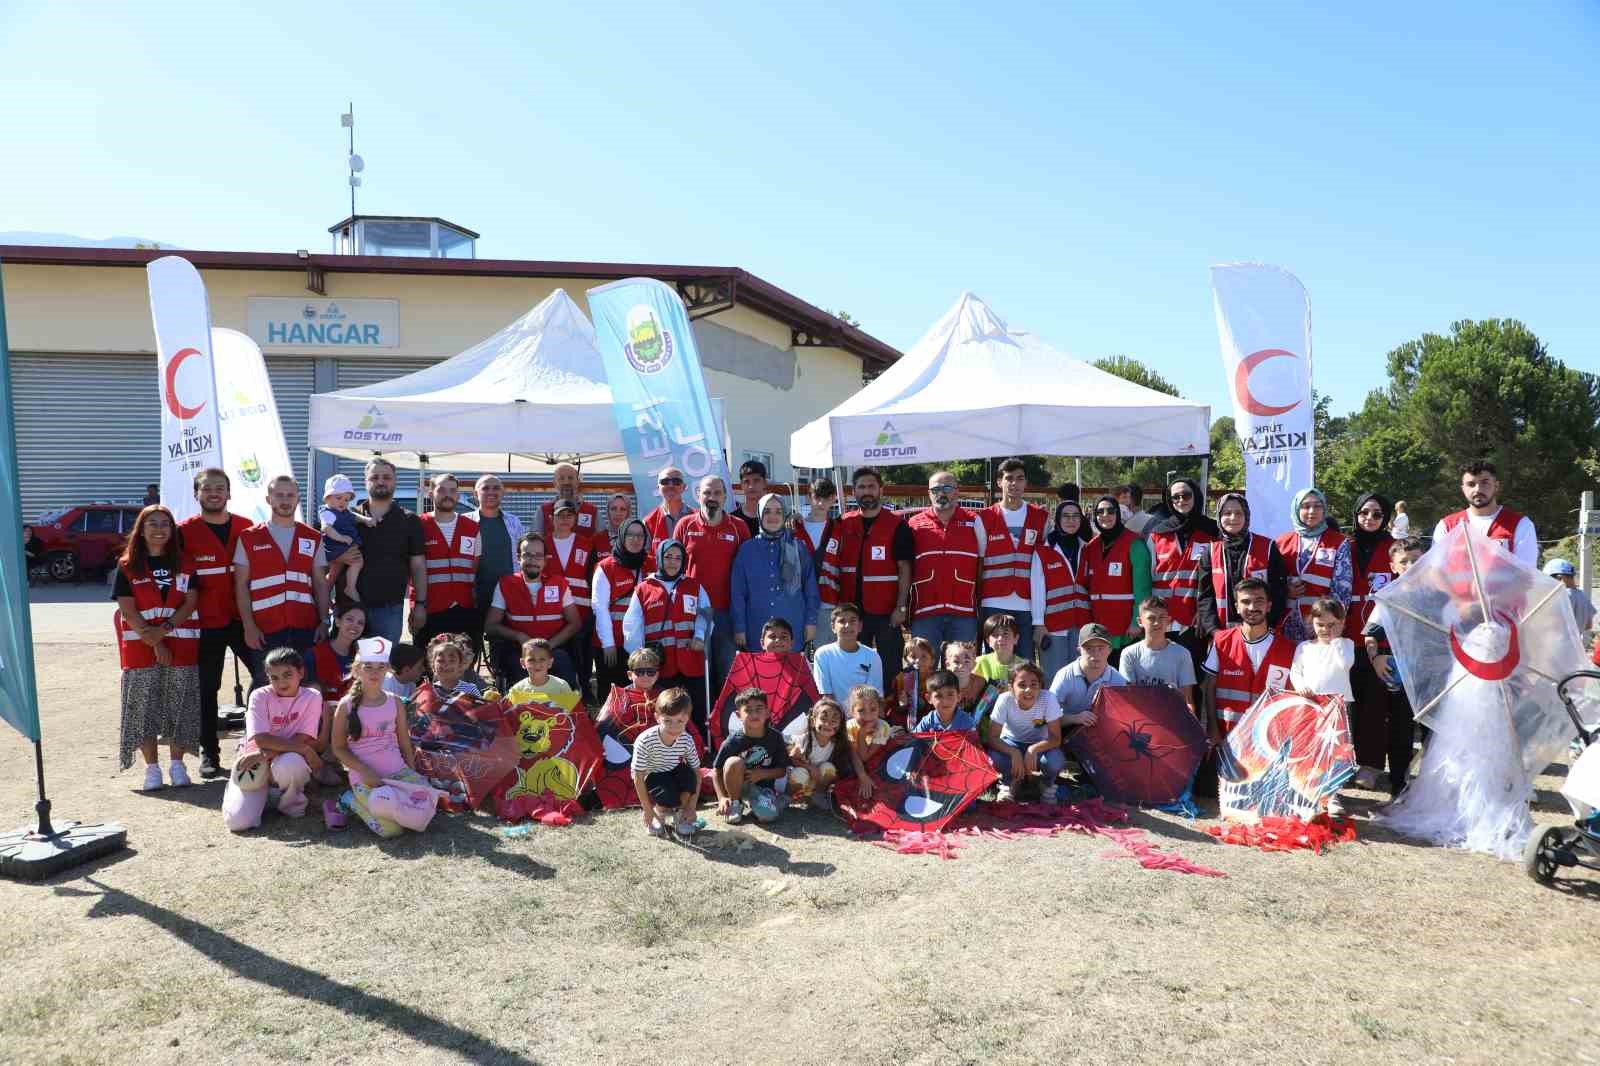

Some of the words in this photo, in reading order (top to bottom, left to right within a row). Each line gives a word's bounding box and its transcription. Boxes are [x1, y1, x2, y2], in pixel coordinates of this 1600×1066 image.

[268, 321, 380, 344] HANGAR
[343, 430, 403, 442] DOSTUM
[864, 446, 917, 457] DOSTUM
